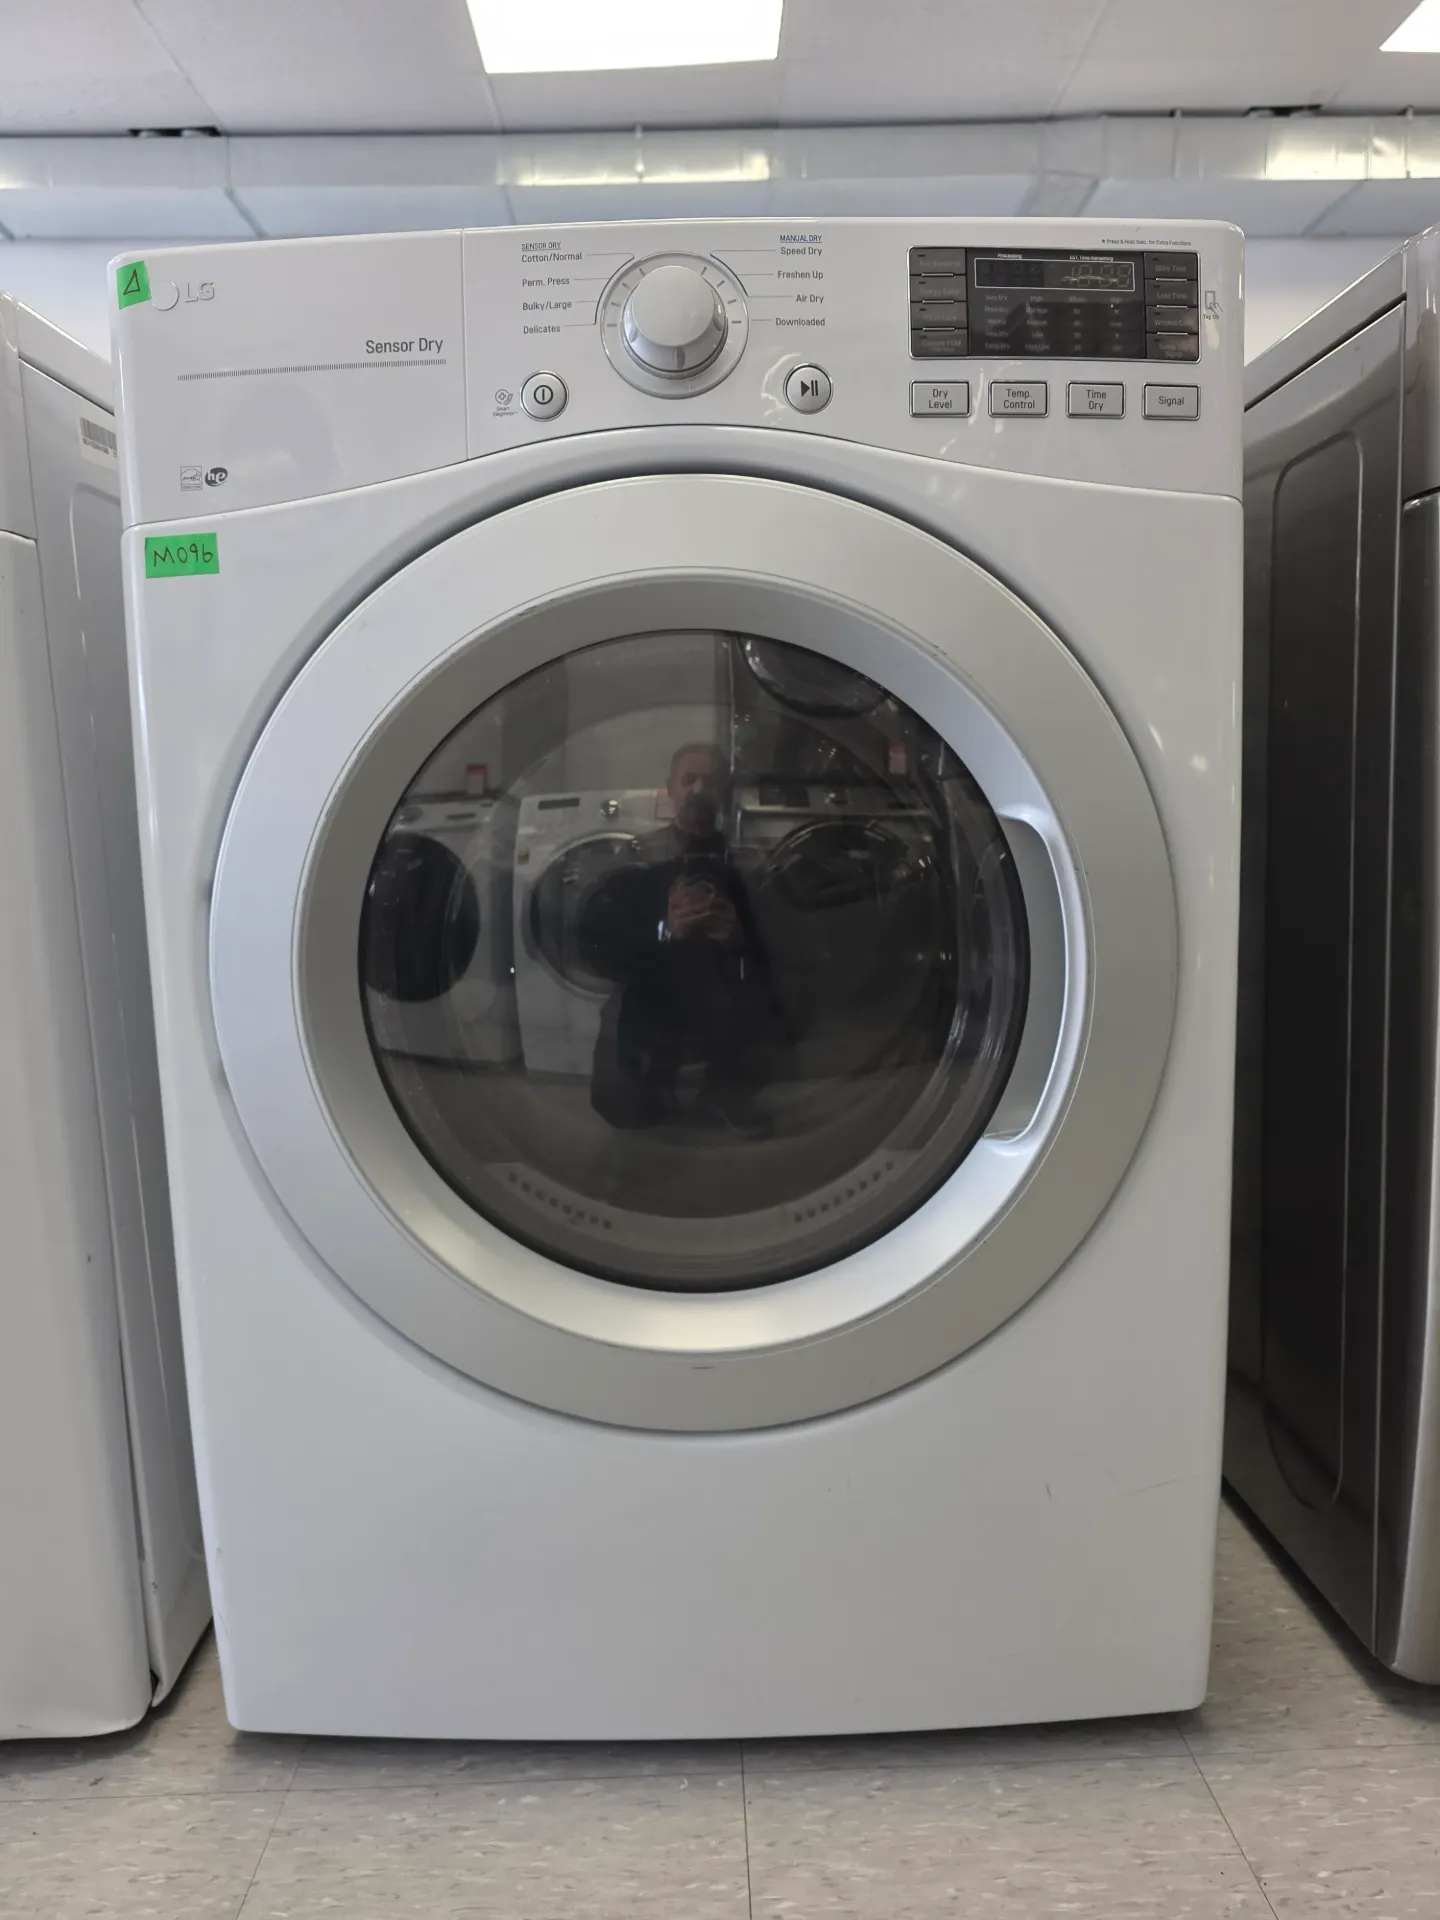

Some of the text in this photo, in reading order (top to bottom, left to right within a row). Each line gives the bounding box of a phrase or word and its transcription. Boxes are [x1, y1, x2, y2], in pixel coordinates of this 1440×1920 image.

[780, 246, 822, 256] Speed Dry
[522, 252, 582, 262] Cotton/Normal
[778, 270, 824, 280] Freshen Up
[548, 278, 570, 286] Press
[184, 281, 215, 303] LG
[810, 294, 824, 304] Dry
[522, 301, 572, 311] Bulky/Large
[776, 318, 826, 326] Downloaded
[524, 326, 560, 334] Delicates
[366, 337, 444, 354] Sensor Dry
[932, 388, 948, 398] Dry
[1006, 388, 1032, 400] Temp.
[1086, 390, 1106, 398] Time
[928, 400, 952, 408] Level
[1004, 400, 1035, 408] Control
[1088, 401, 1104, 411] Dry
[1158, 396, 1184, 407] Signal
